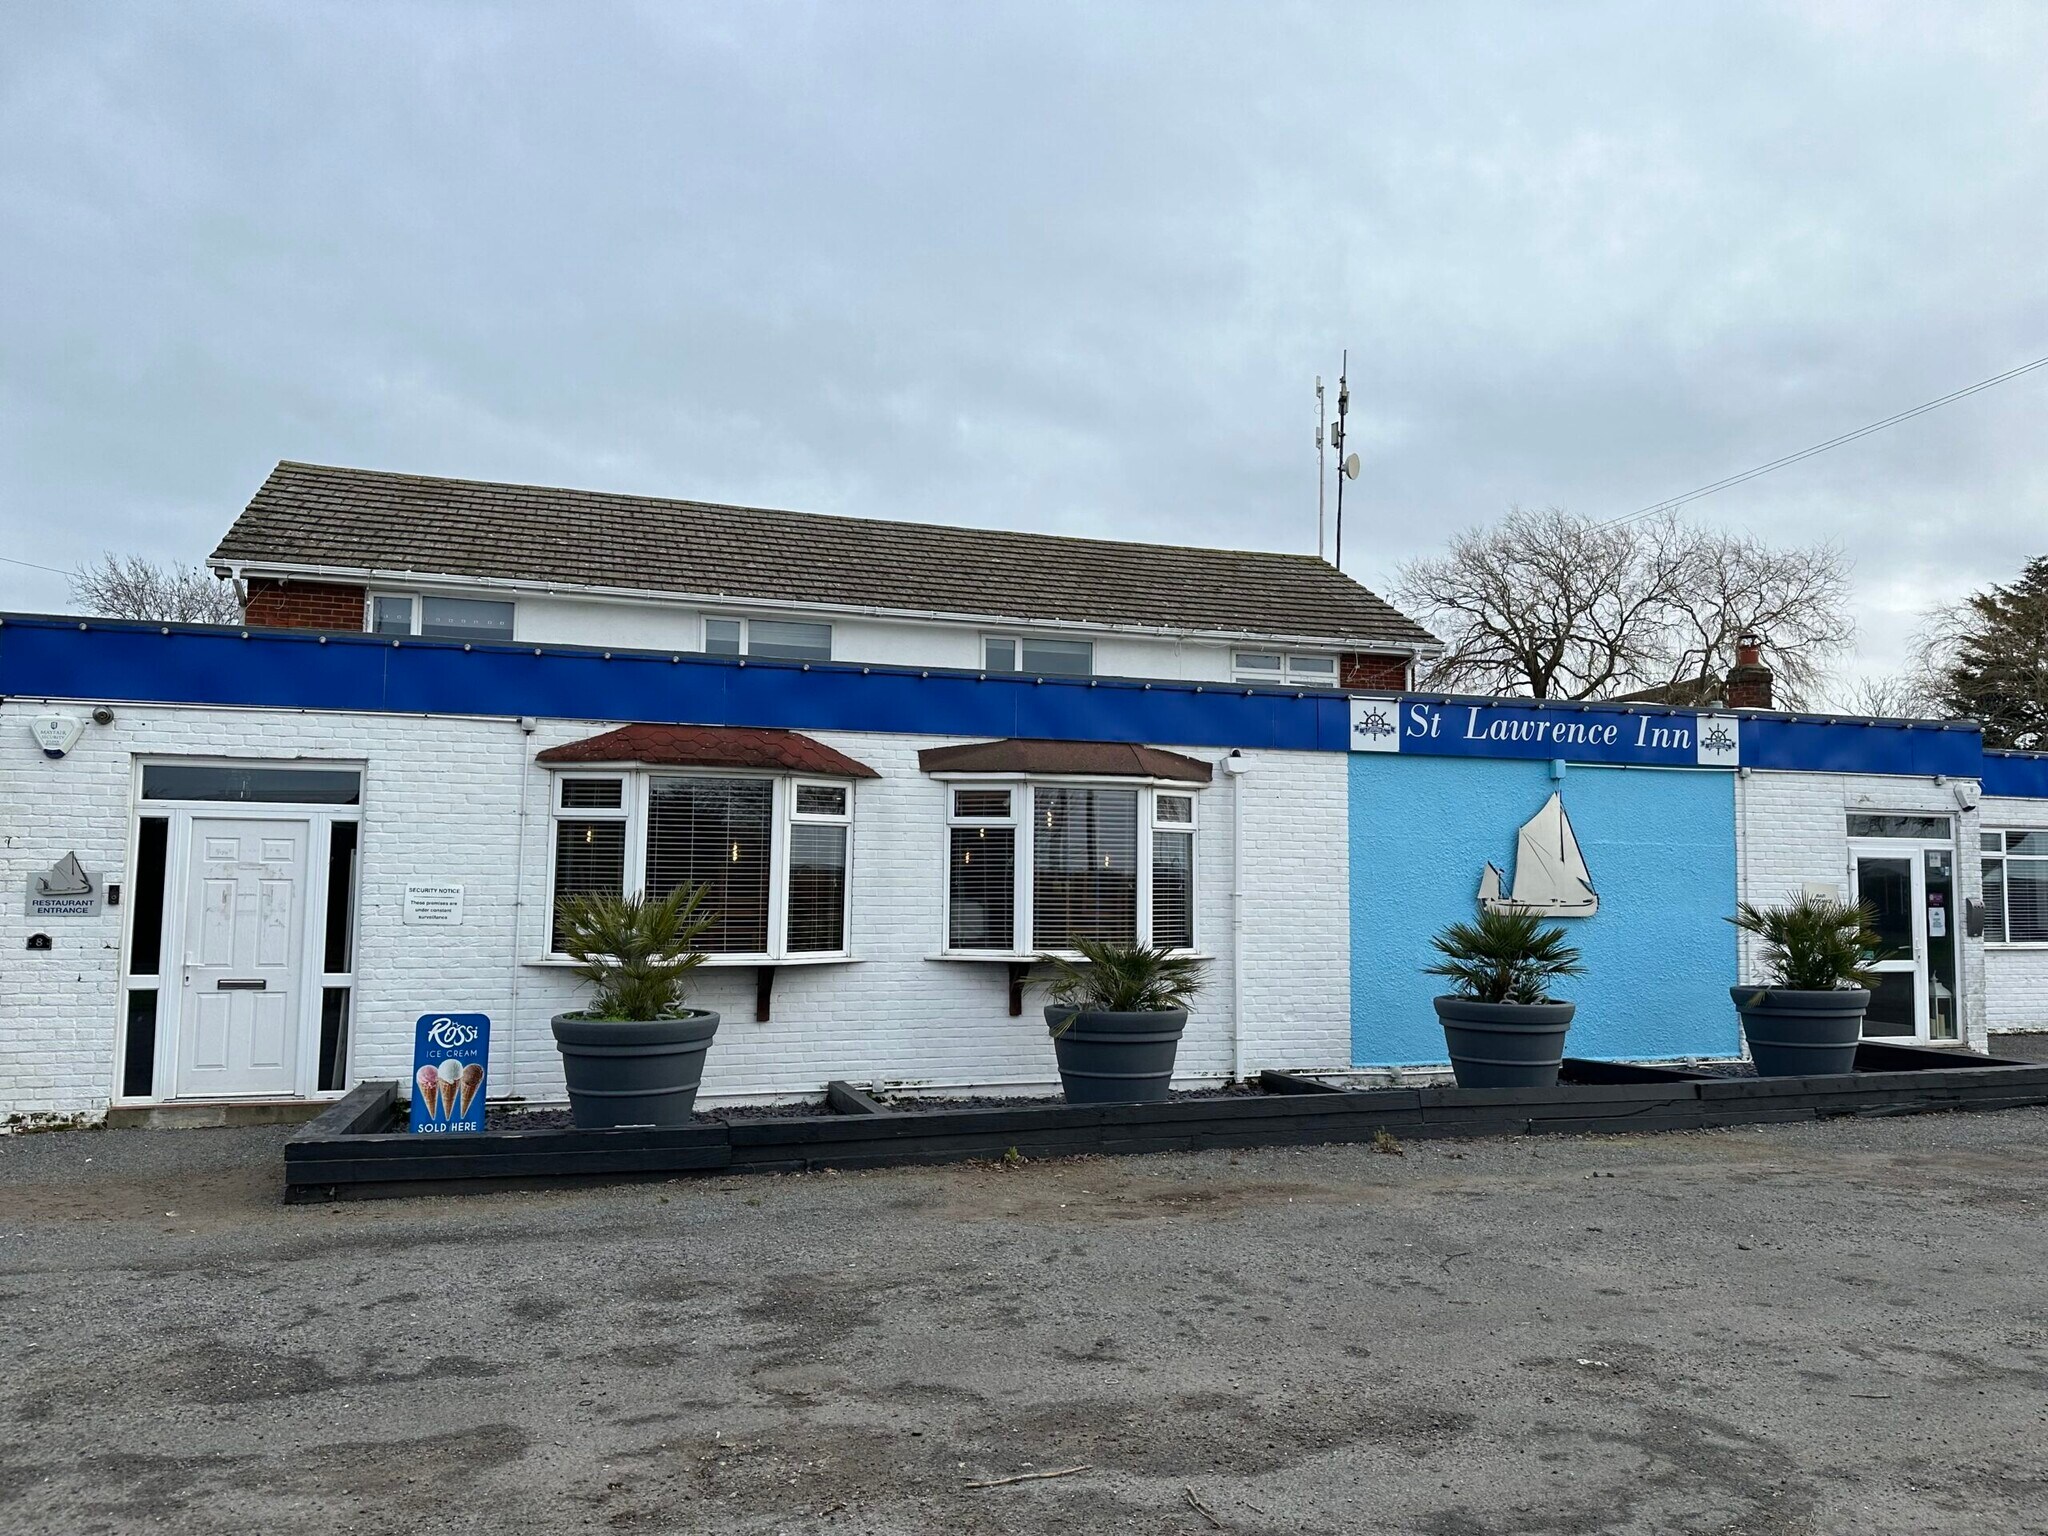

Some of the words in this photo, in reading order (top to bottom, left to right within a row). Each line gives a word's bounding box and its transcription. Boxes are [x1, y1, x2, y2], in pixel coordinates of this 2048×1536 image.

[1406, 703, 1442, 738] St
[1463, 706, 1618, 745] Lawrence
[1634, 715, 1692, 749] Inn
[35, 938, 43, 947] 8
[426, 1050, 442, 1058] ICE
[446, 1049, 478, 1058] CREAM
[417, 1123, 447, 1133] SOLD
[451, 1121, 477, 1132] HERE
